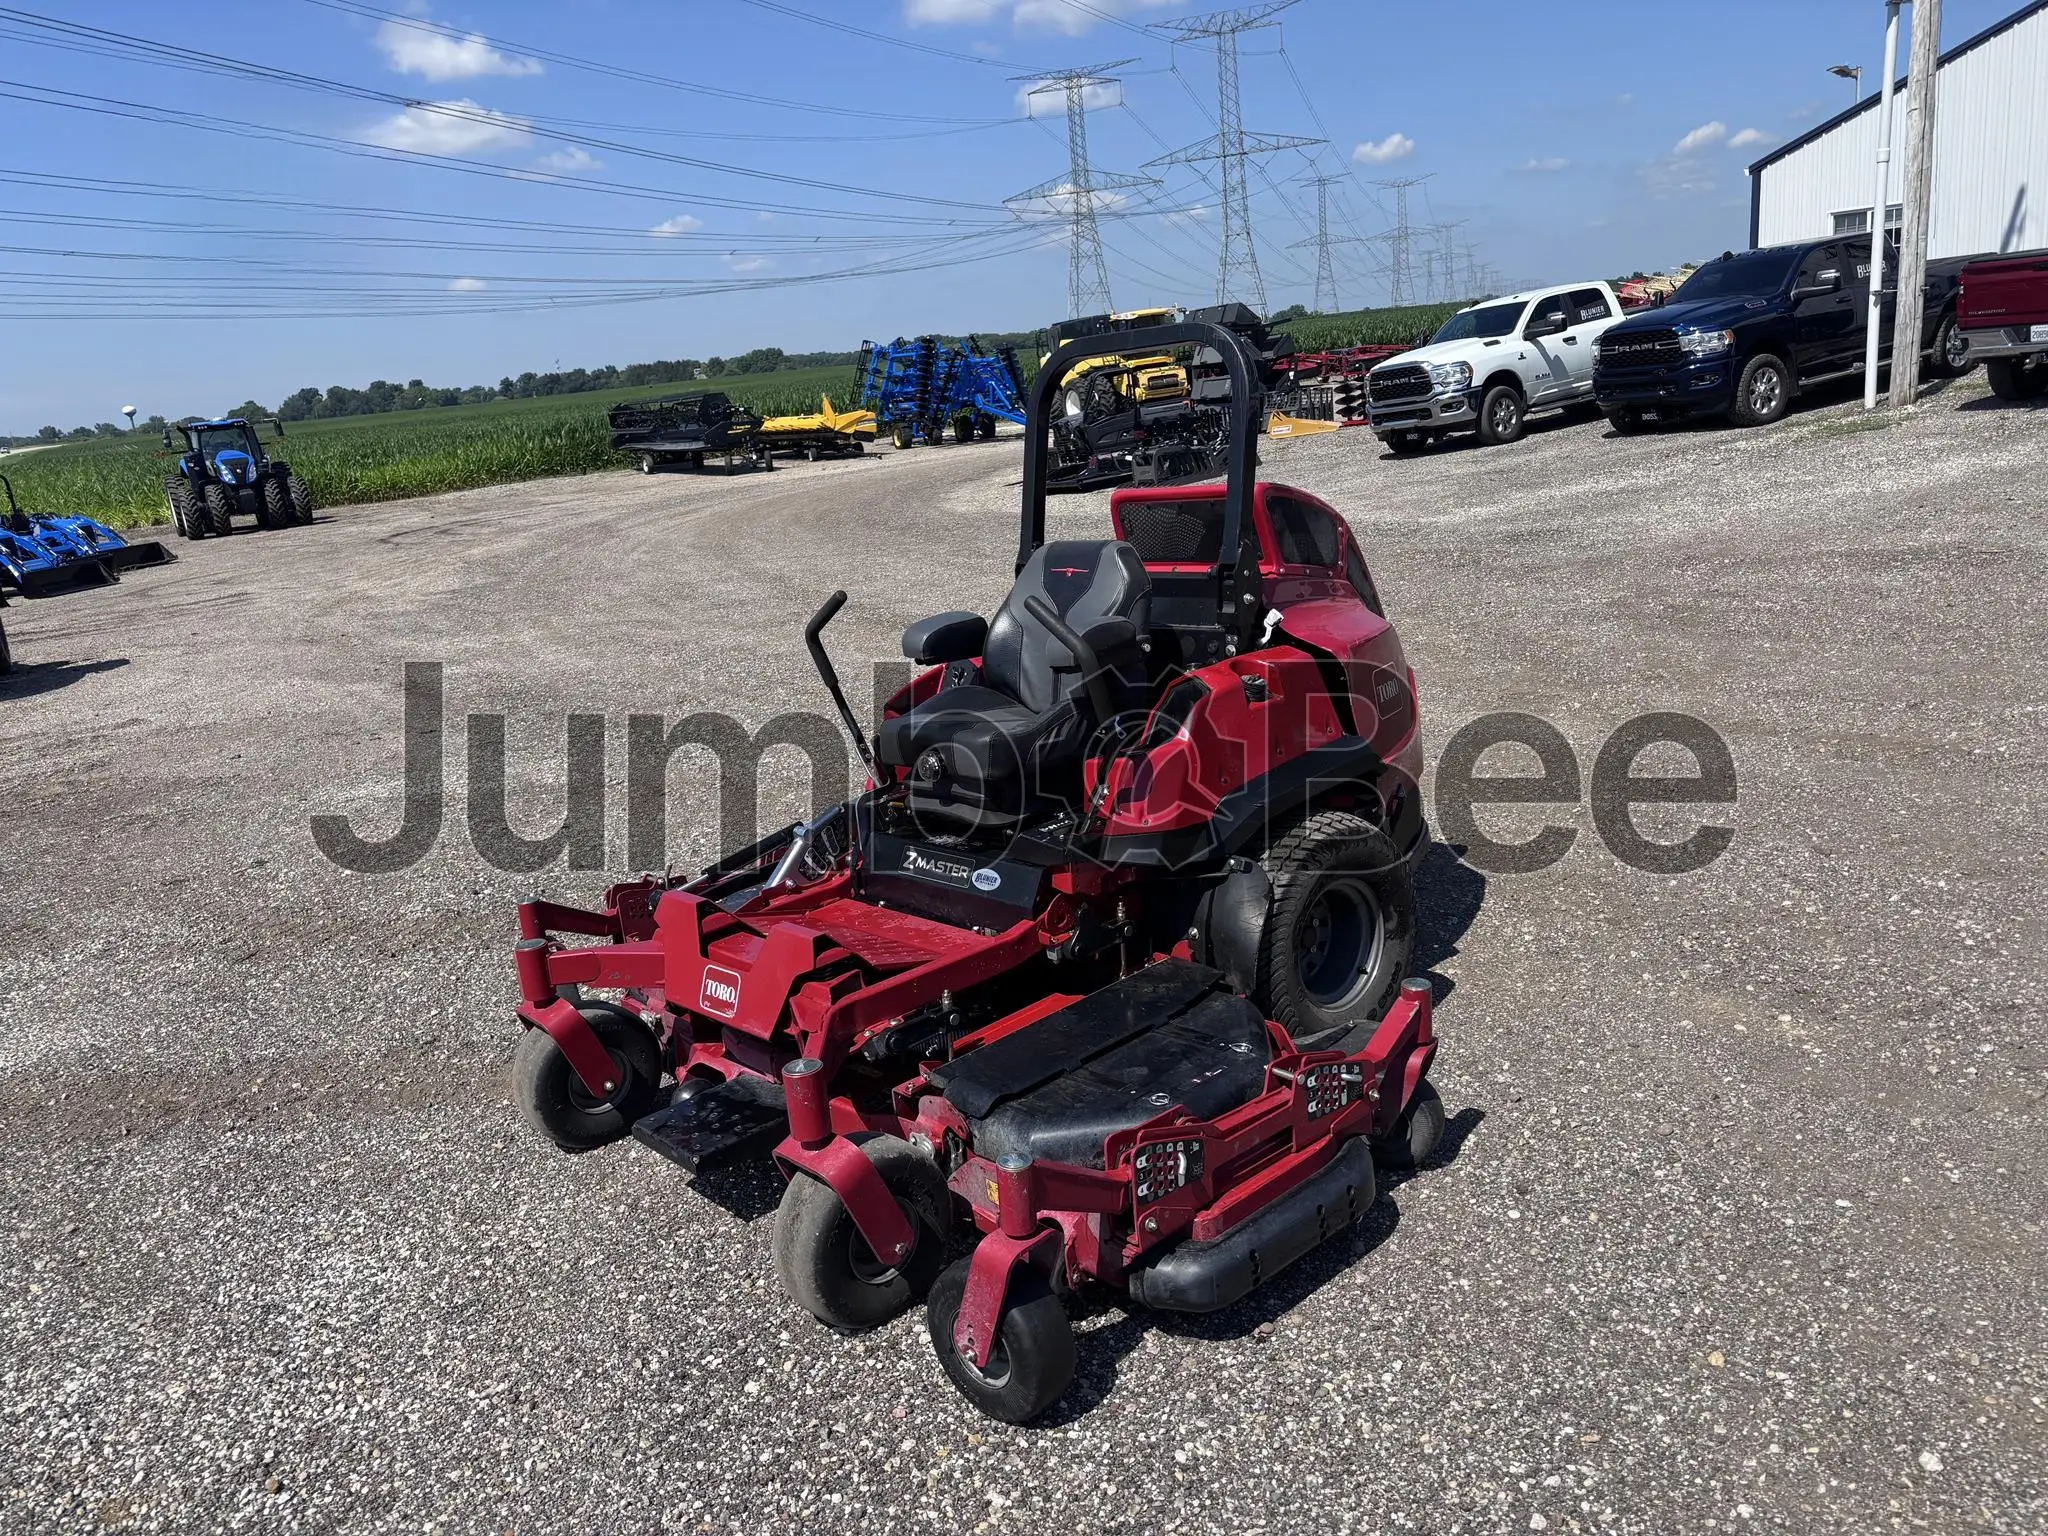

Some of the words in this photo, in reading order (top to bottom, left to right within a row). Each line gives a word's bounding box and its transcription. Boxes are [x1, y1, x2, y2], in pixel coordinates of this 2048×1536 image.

[1619, 343, 1652, 352] RAM
[1383, 377, 1409, 386] RAM
[1376, 678, 1399, 703] TORO
